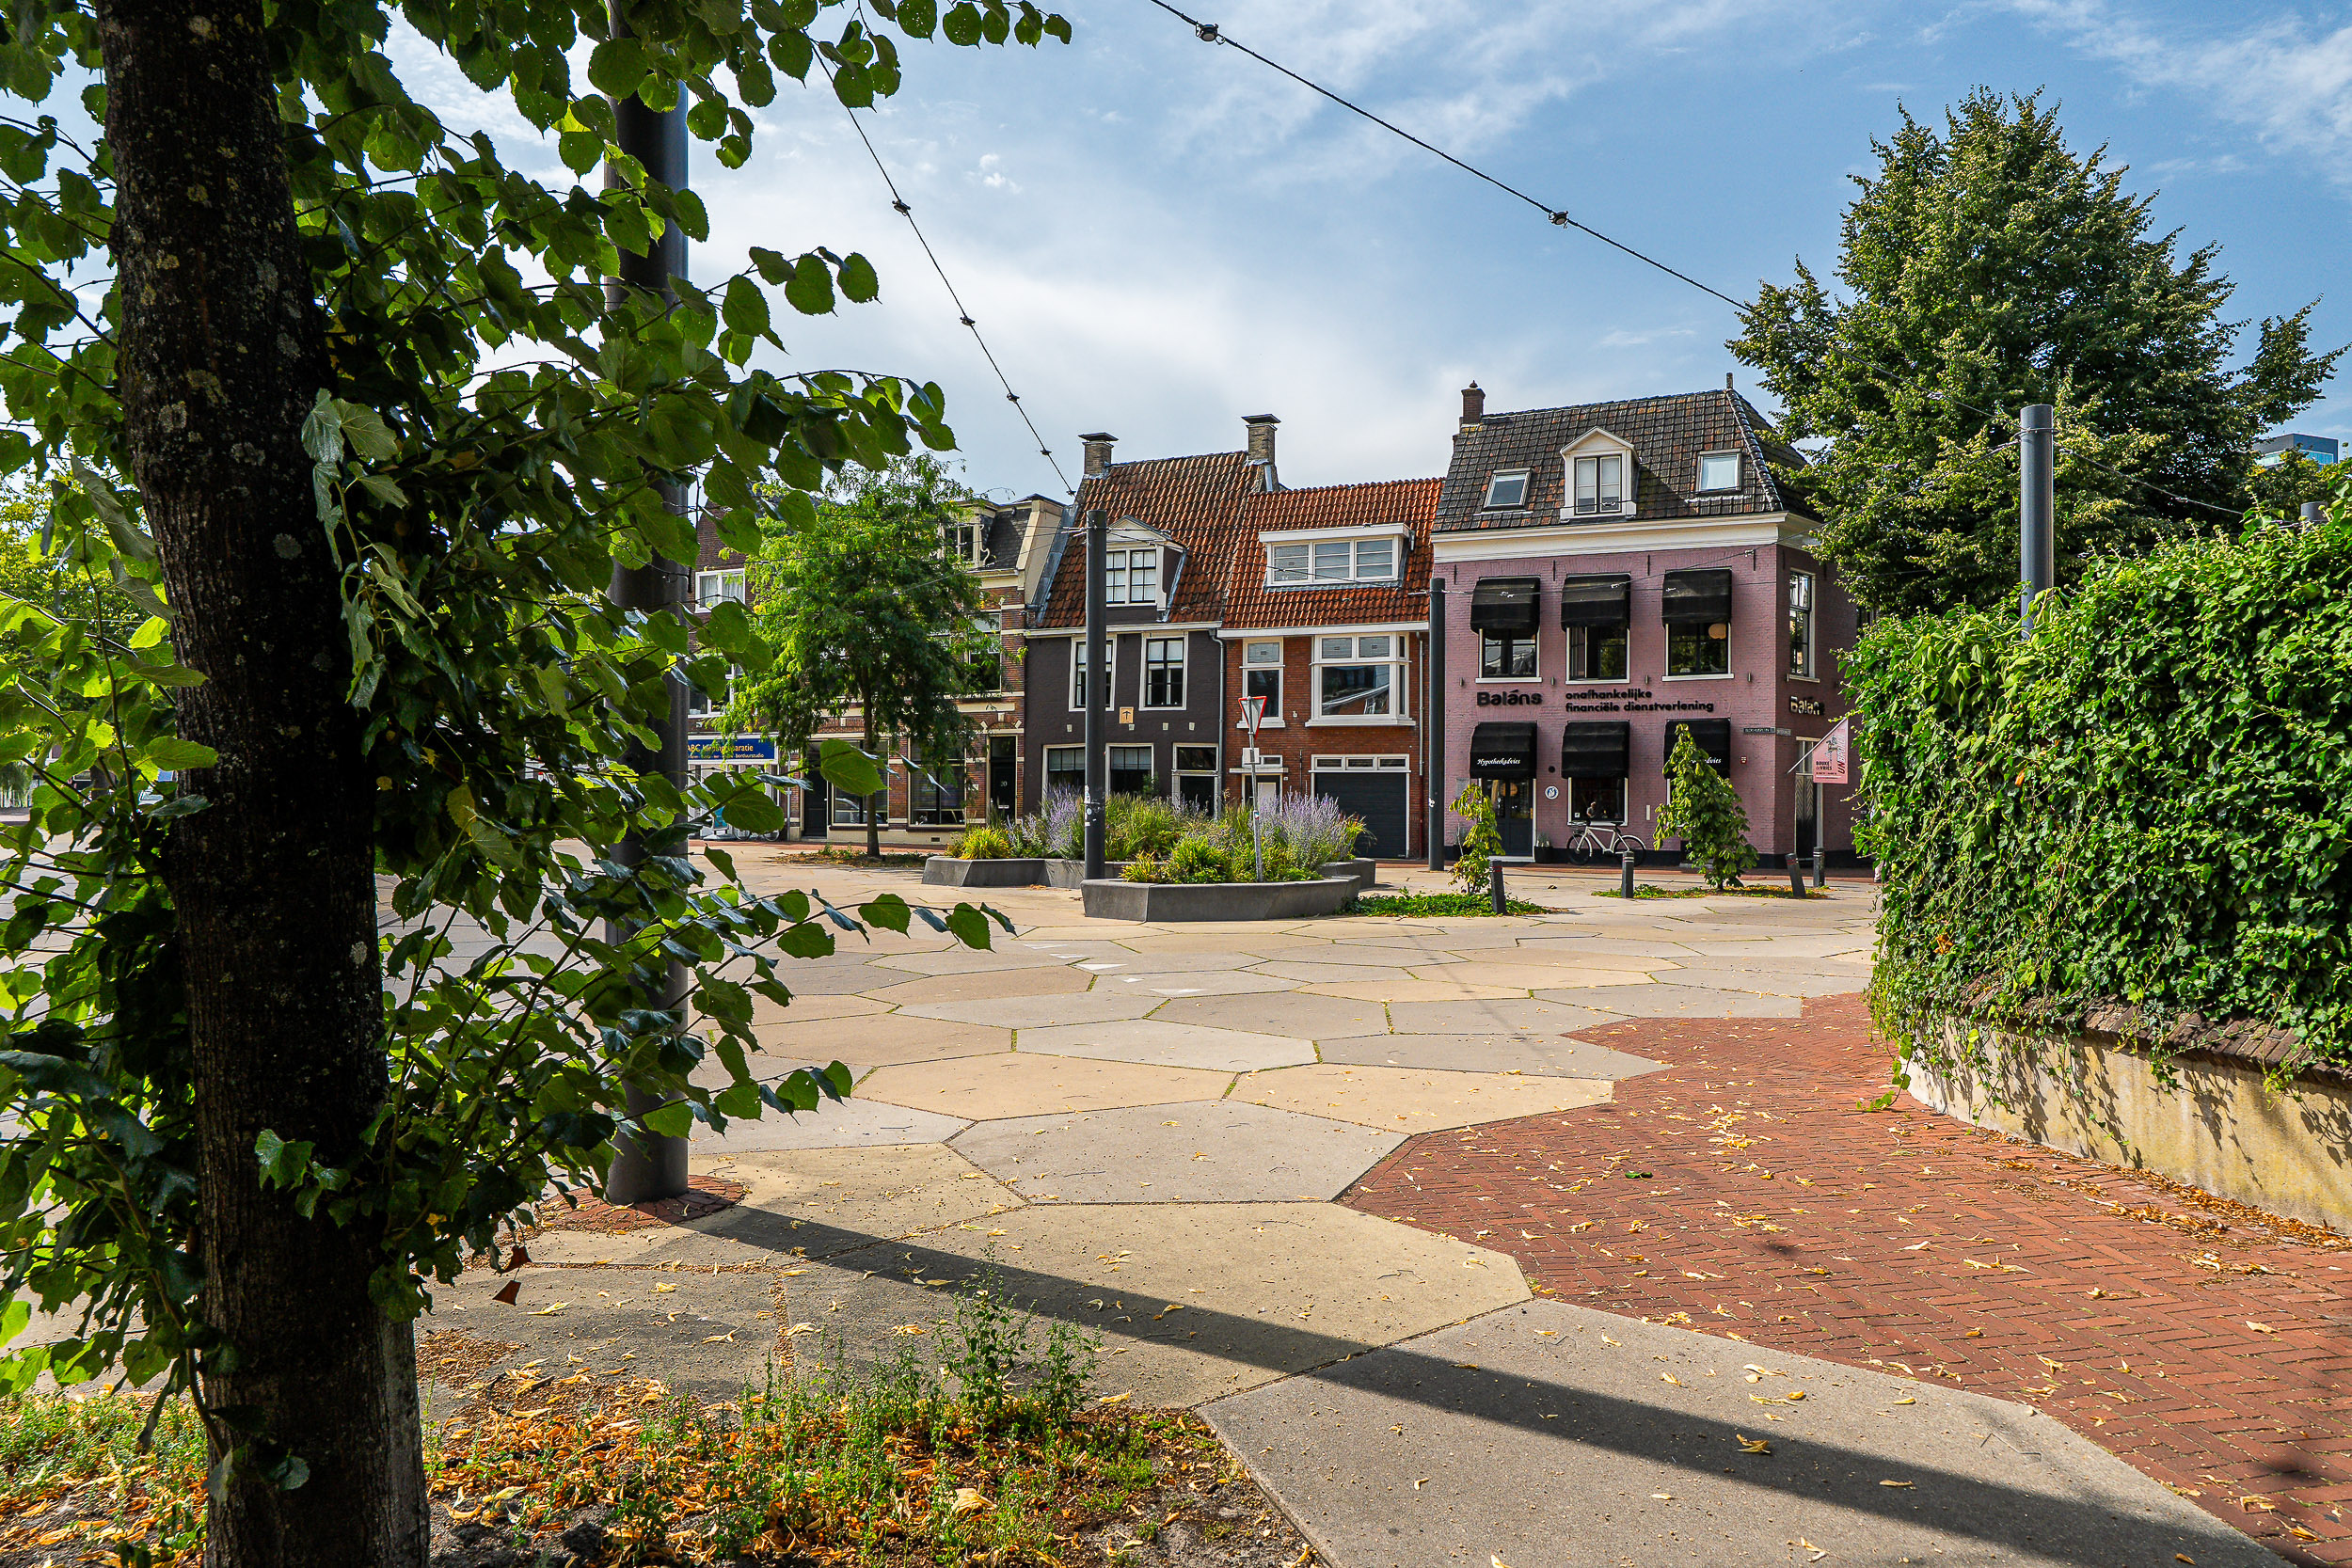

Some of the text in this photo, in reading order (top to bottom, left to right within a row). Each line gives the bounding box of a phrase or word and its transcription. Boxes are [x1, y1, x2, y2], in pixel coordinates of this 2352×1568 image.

[1476, 689, 1543, 705] Baláns
[1565, 689, 1652, 701] onafhankelijke
[1565, 701, 1714, 712] financiële dienstverlening
[1477, 757, 1521, 767] Hypotheekadvies
